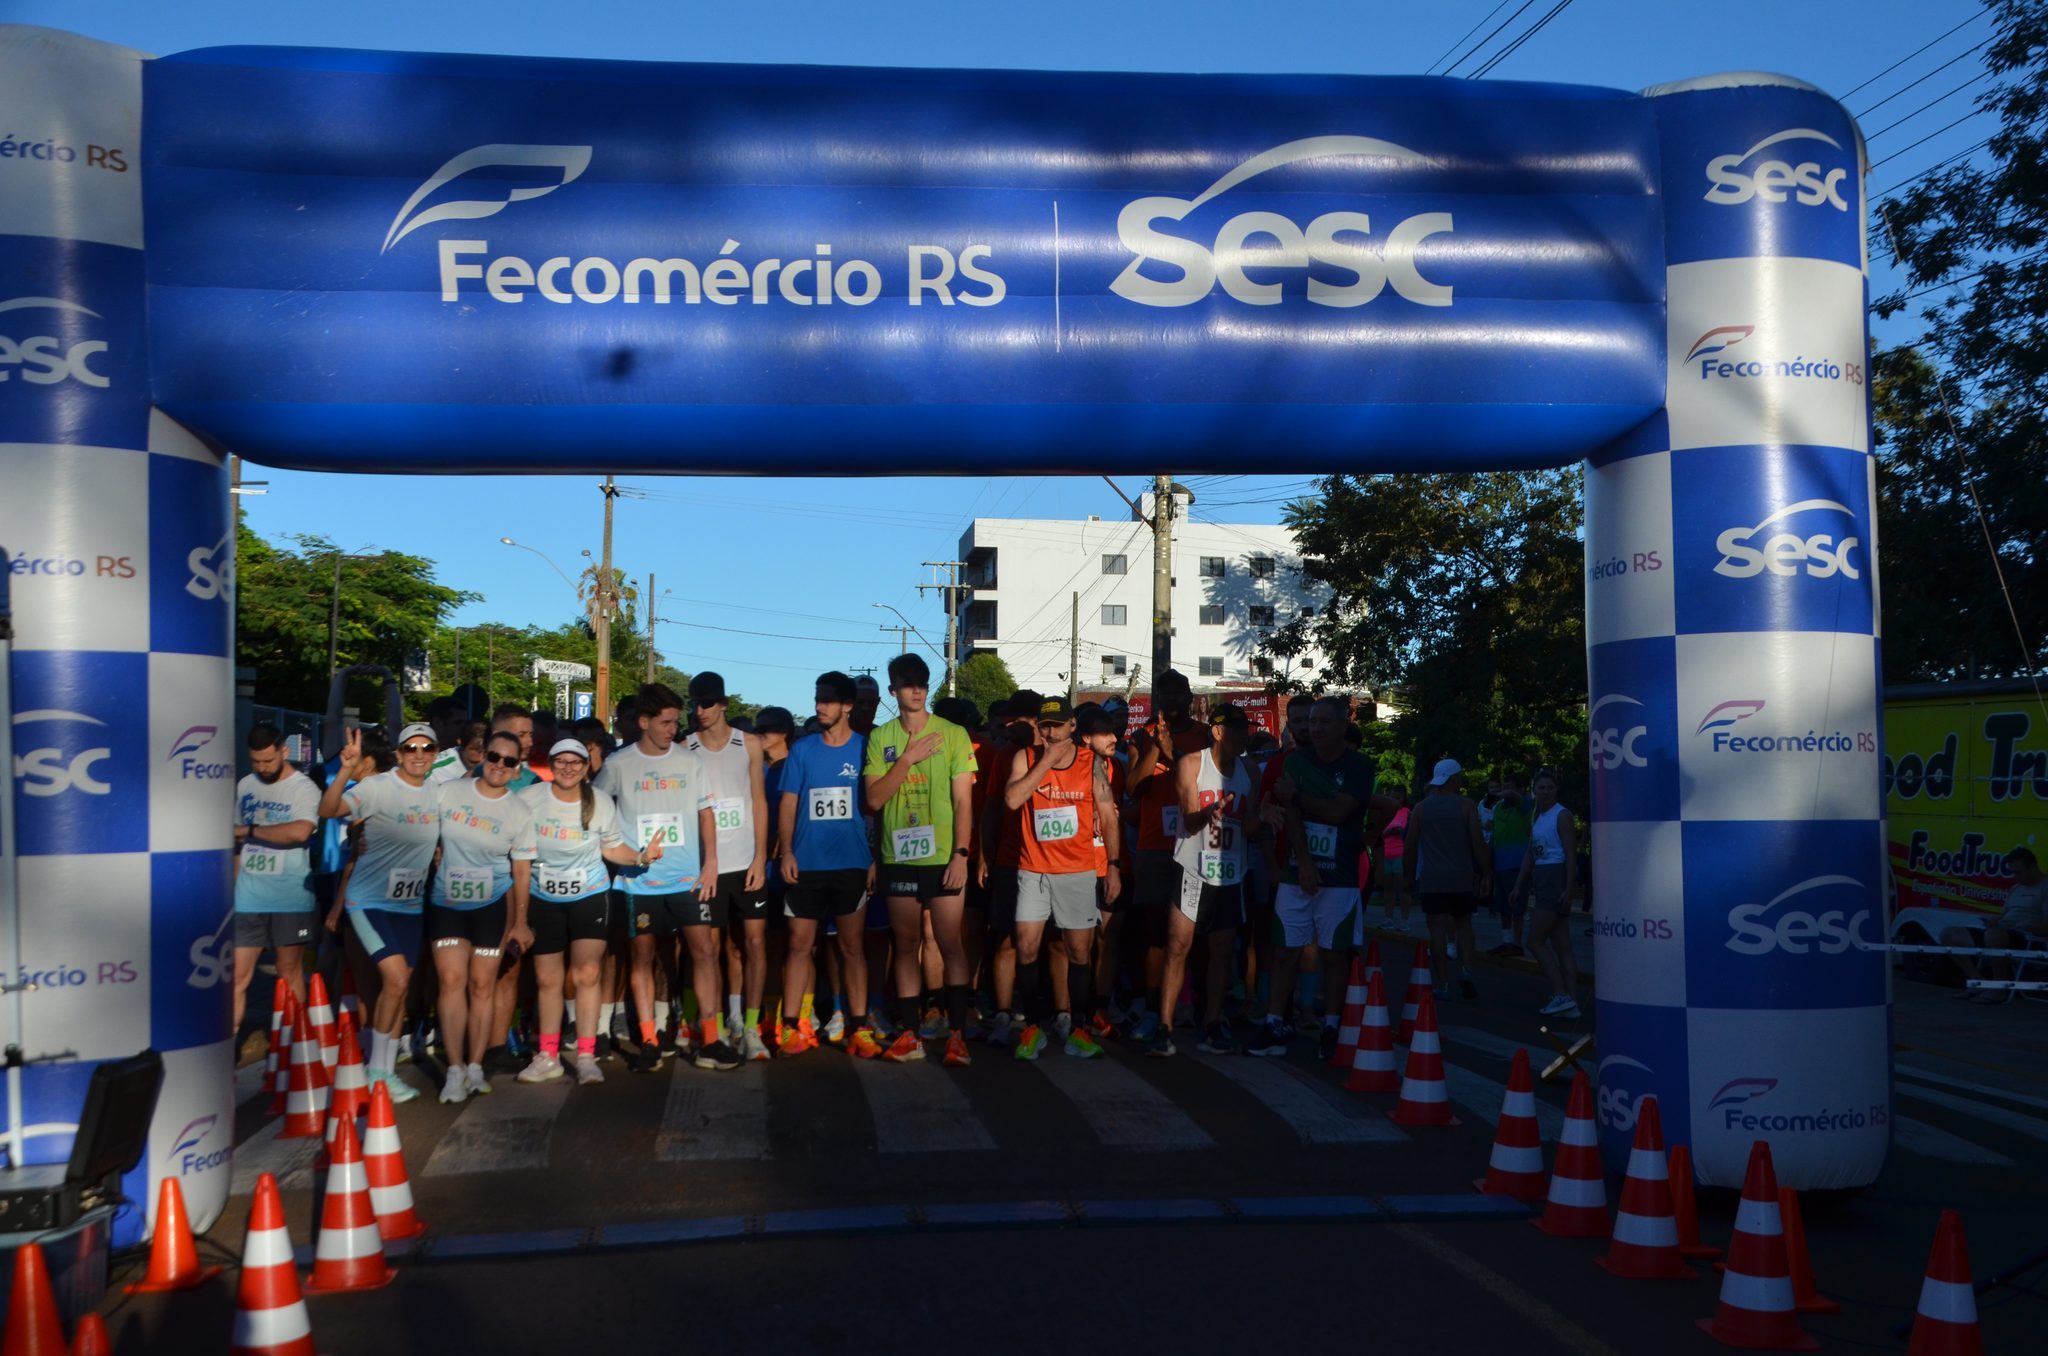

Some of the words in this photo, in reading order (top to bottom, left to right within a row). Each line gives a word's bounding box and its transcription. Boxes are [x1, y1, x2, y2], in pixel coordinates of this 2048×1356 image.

[87, 143, 128, 172] RS
[1703, 154, 1848, 212] Sesc
[1109, 196, 1453, 308] Sesc
[438, 238, 882, 306] Fecomércio
[908, 244, 1007, 306] RS
[1846, 363, 1863, 385] RS
[1633, 551, 1663, 572] RS
[1712, 527, 1860, 580] Sesc
[97, 556, 136, 578] RS
[1713, 731, 1852, 752] Fecomércio
[1858, 732, 1875, 753] RS
[14, 747, 111, 797] sc
[1041, 818, 1074, 838] 494
[900, 837, 931, 858] 479
[1306, 835, 1330, 854] 00
[245, 854, 276, 872] 481
[1206, 861, 1235, 879] 536
[450, 880, 485, 899] 551
[546, 880, 581, 895] 855
[1643, 919, 1673, 940] RS
[1724, 903, 1870, 955] Sesc
[98, 961, 137, 984] RS
[1725, 1108, 1865, 1131] Fecomércio
[1870, 1104, 1888, 1127] RS
